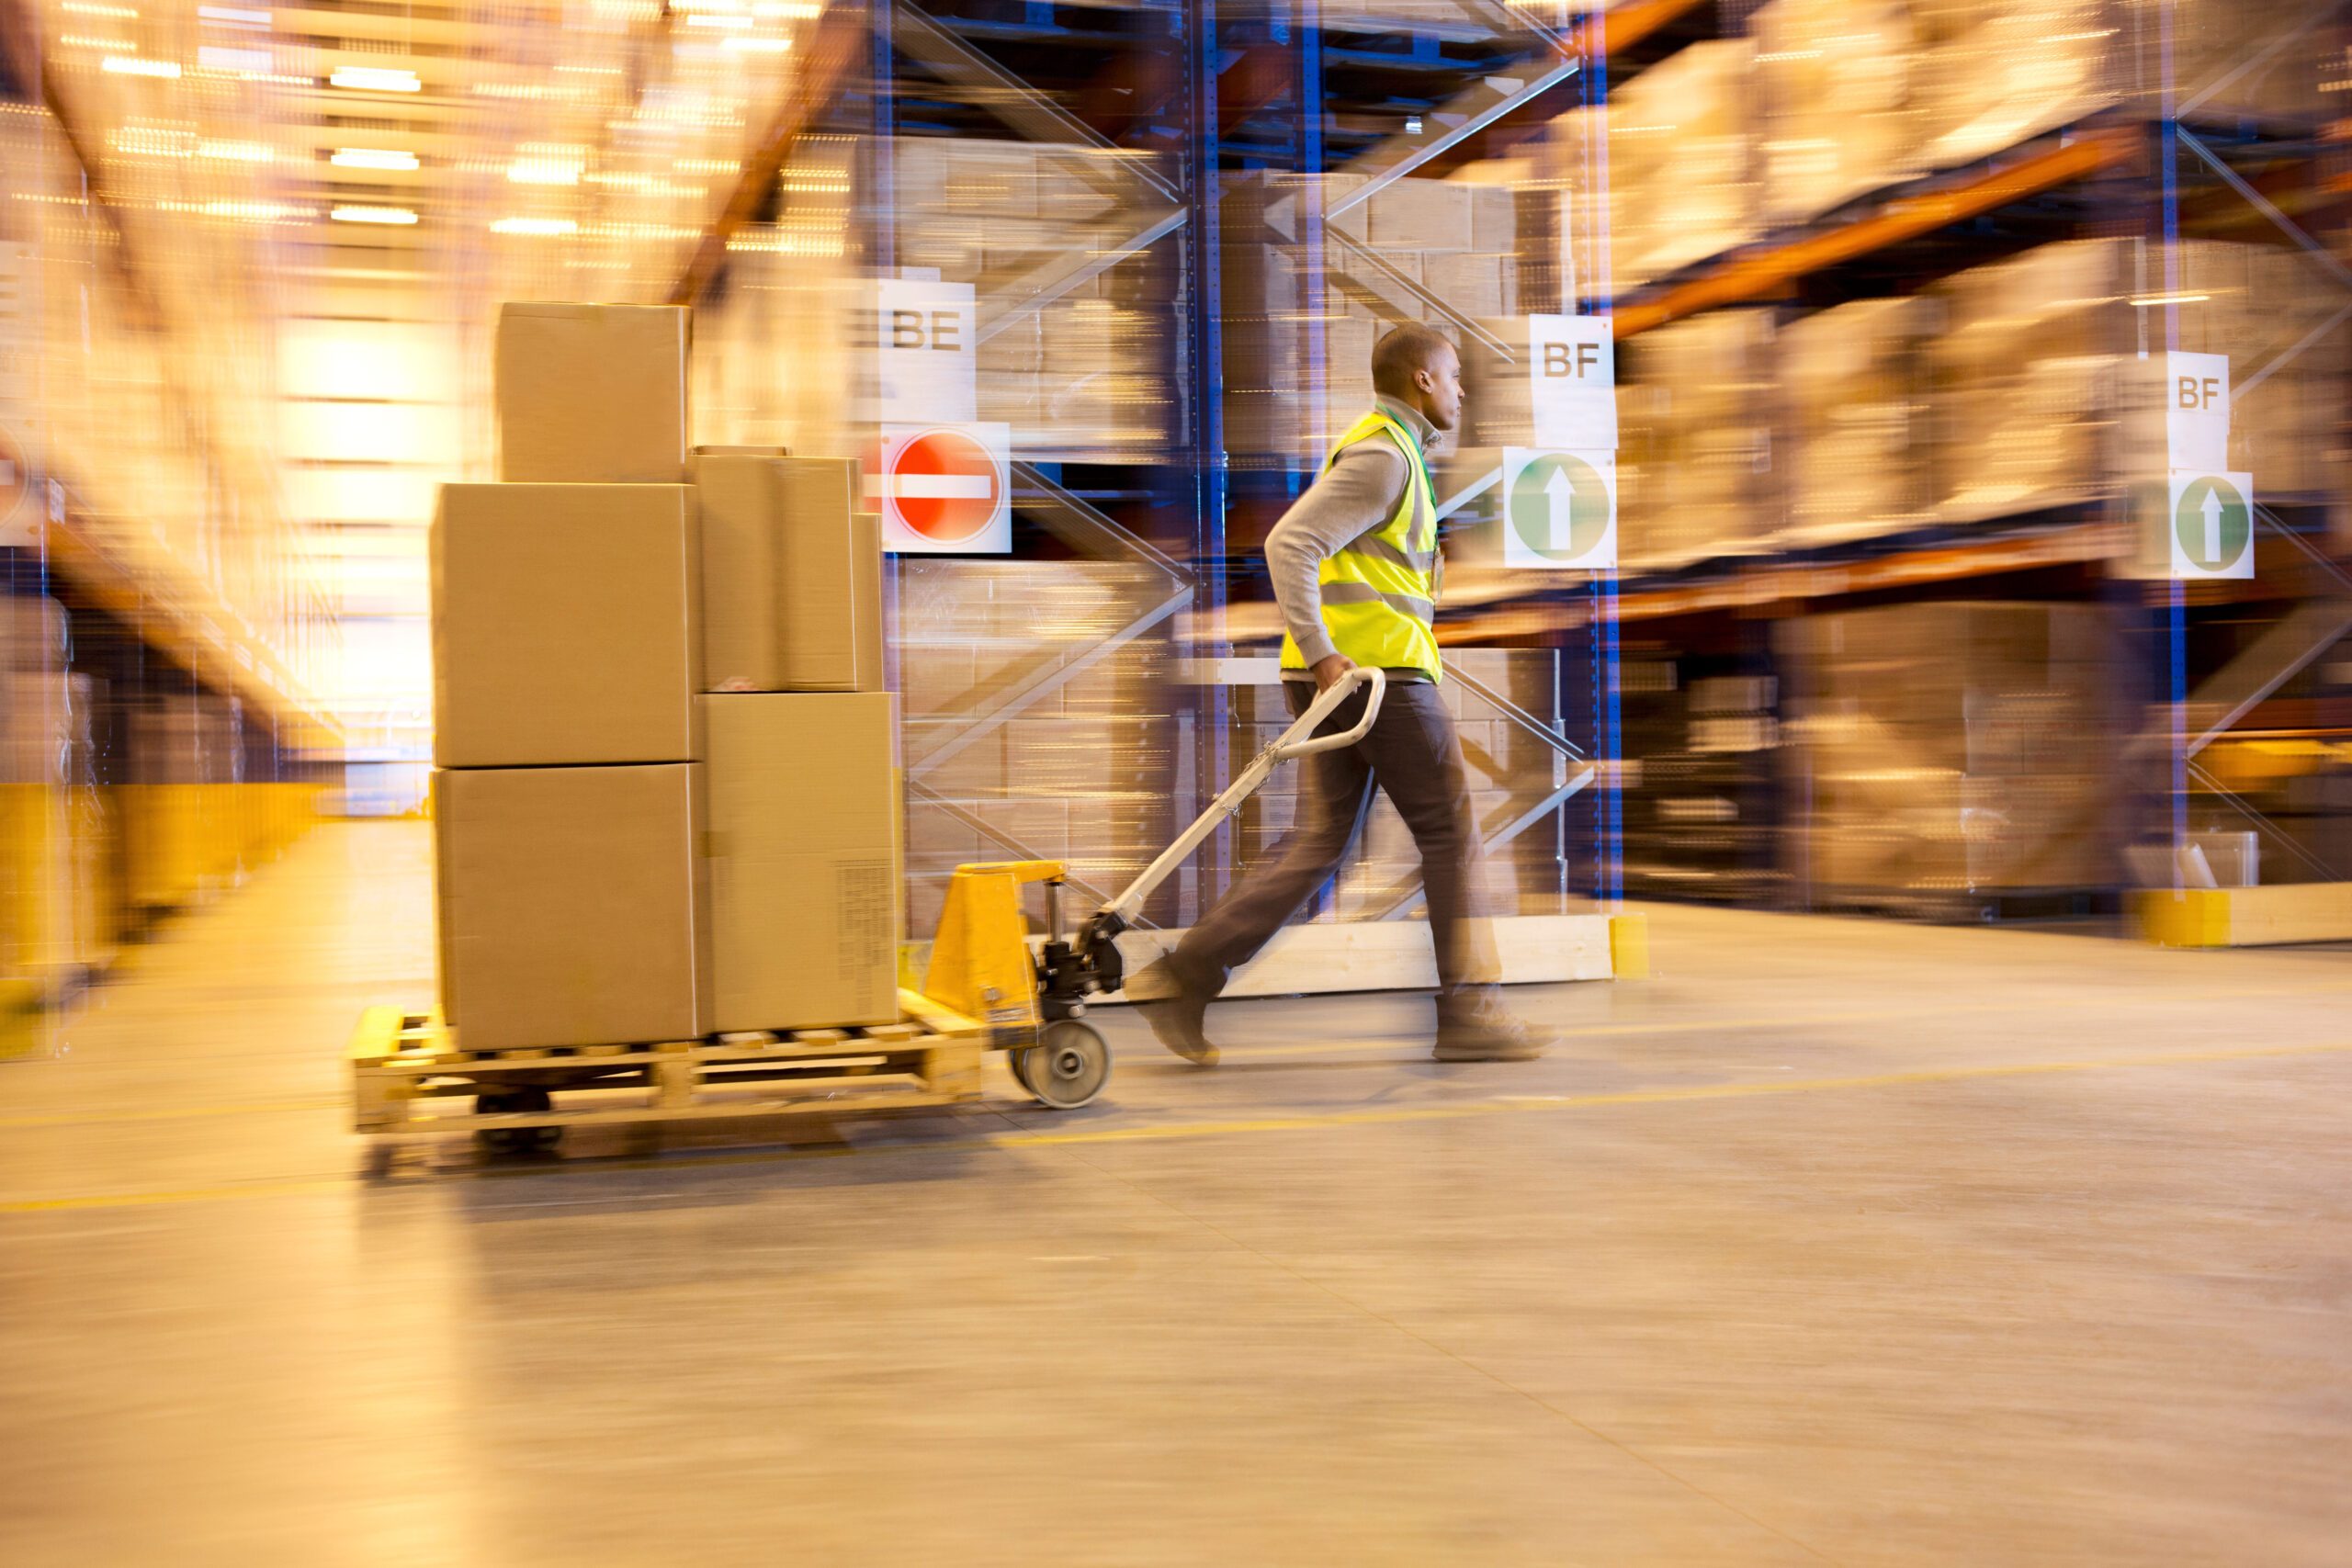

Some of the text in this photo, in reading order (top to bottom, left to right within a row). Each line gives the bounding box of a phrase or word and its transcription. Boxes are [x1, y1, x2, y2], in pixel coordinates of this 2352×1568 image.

[892, 310, 961, 351] BE
[1544, 342, 1600, 378] BF
[2177, 376, 2220, 410] BF
